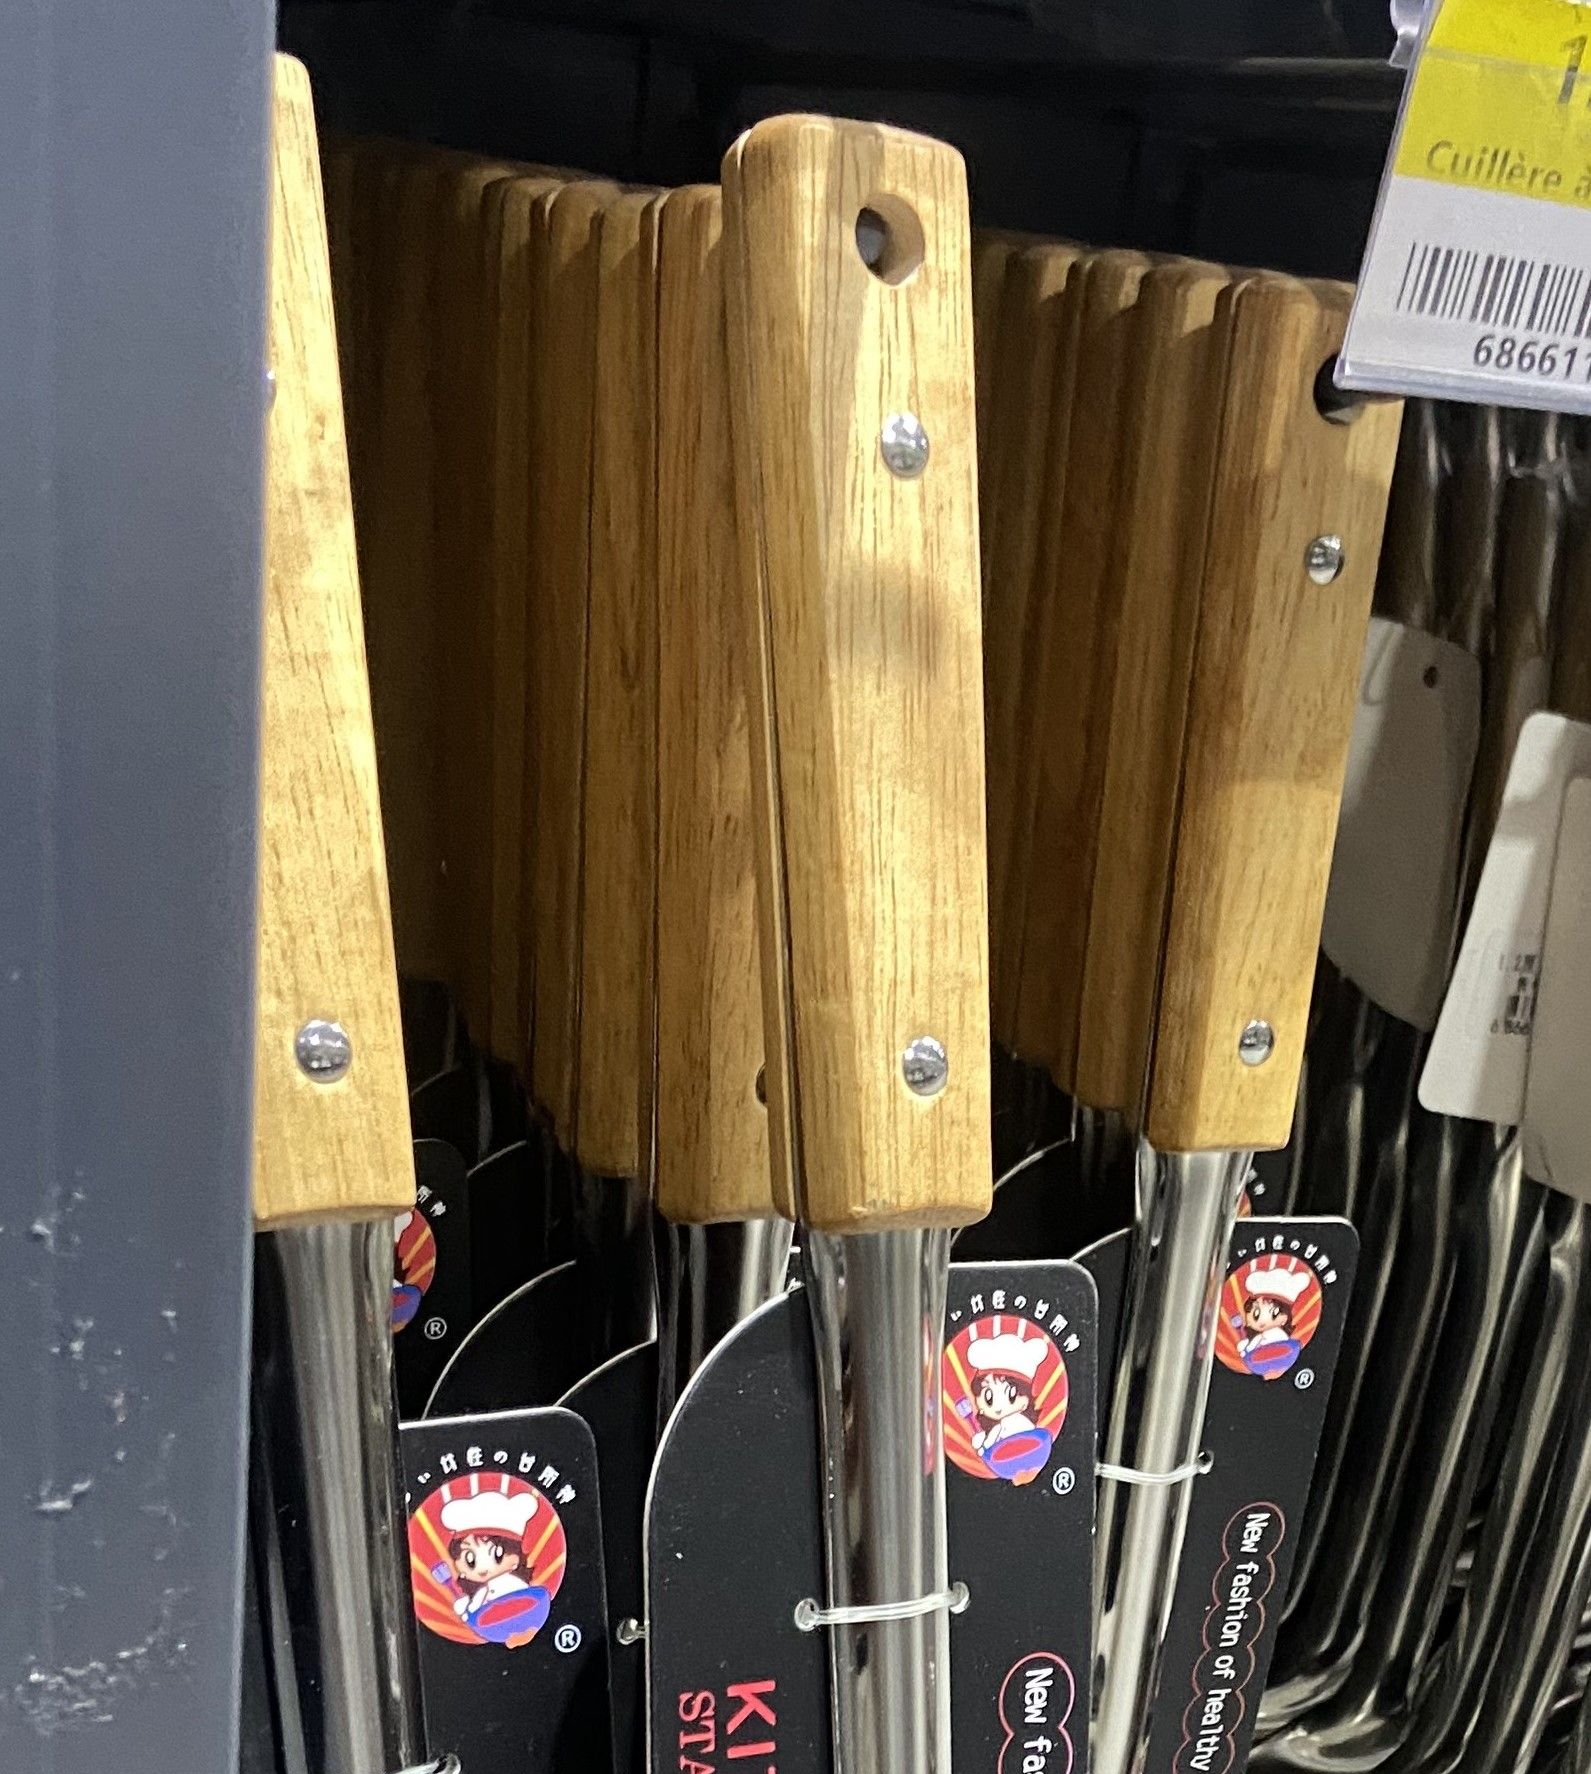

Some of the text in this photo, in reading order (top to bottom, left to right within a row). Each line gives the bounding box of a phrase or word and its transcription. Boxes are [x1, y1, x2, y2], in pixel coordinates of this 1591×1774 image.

[1427, 140, 1562, 192] Cuillère
[1240, 1513, 1271, 1553] New
[1219, 1560, 1259, 1648] fashion
[1214, 1656, 1236, 1680] of
[1026, 1669, 1054, 1724] New
[1190, 1688, 1232, 1773] healthy
